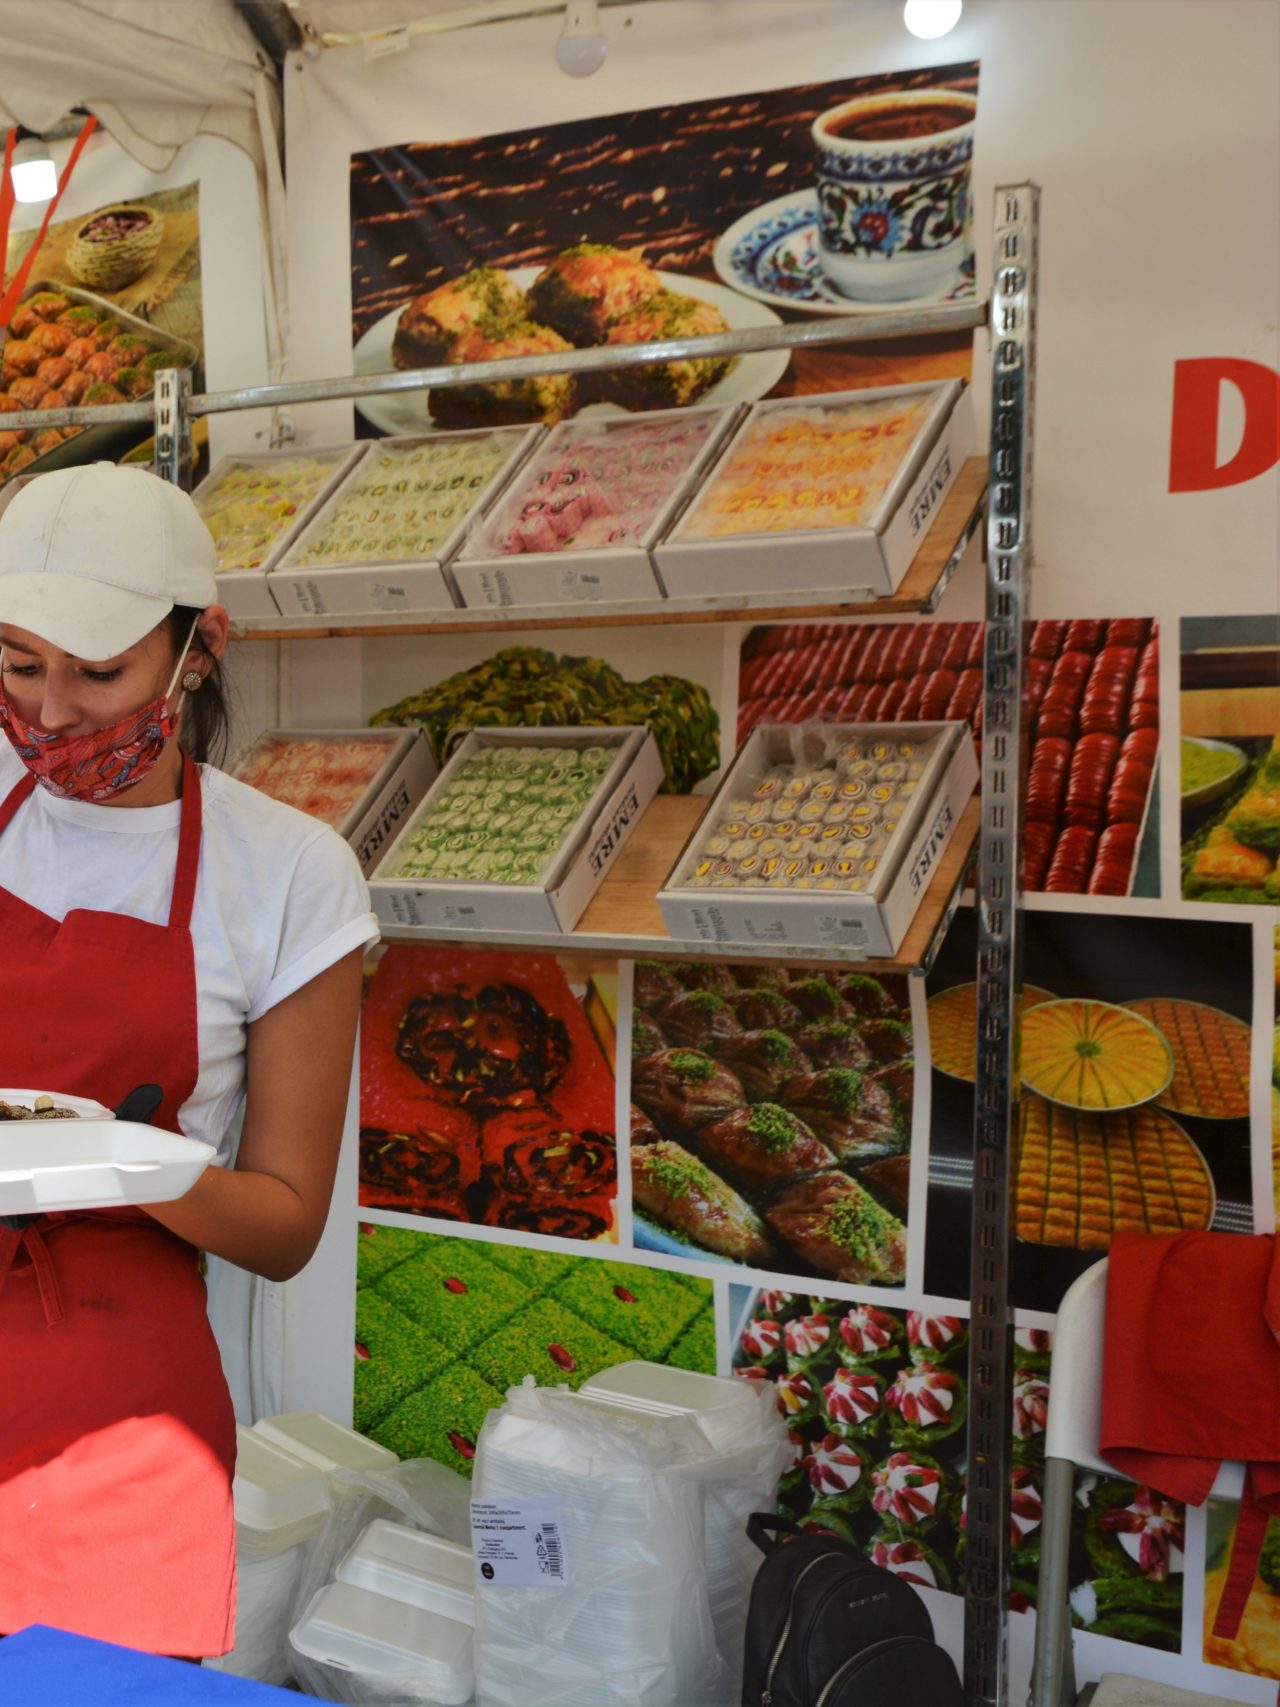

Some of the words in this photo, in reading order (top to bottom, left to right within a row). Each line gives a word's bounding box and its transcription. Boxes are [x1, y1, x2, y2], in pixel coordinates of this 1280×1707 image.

[912, 458, 951, 538] EMRE
[360, 790, 409, 867] EMRE
[592, 793, 639, 877] EMRE
[911, 806, 952, 896] EMRE
